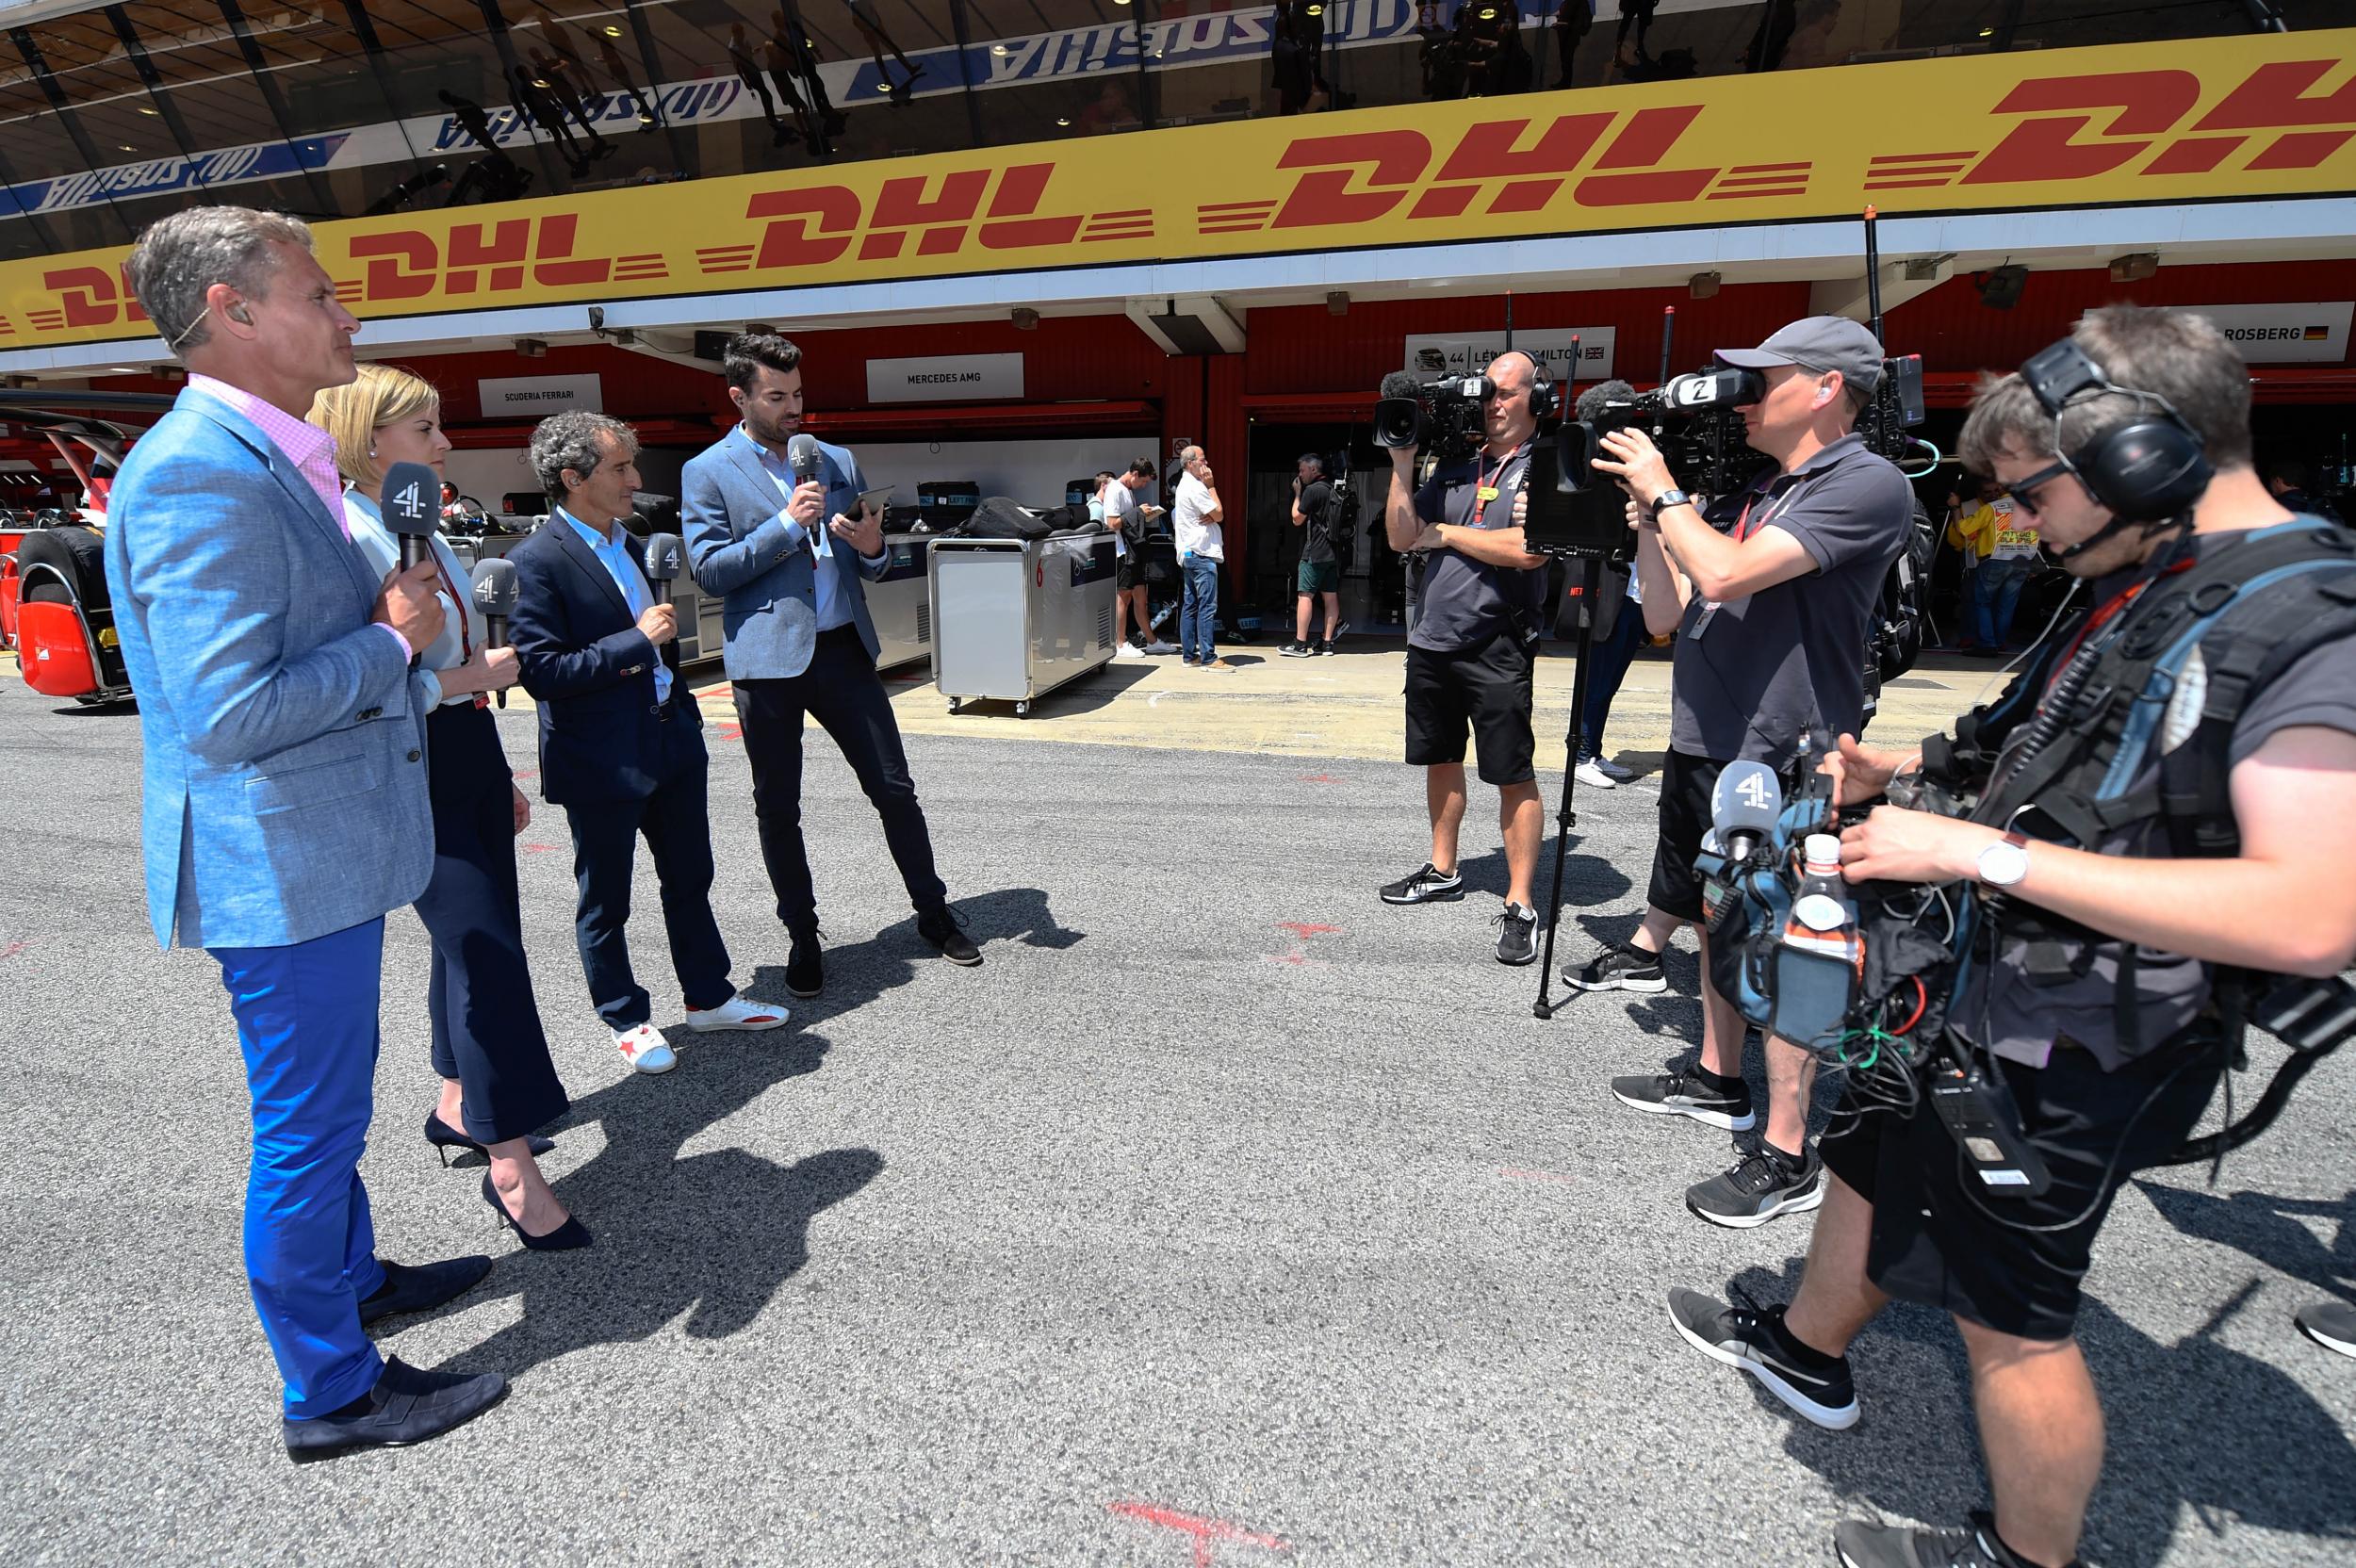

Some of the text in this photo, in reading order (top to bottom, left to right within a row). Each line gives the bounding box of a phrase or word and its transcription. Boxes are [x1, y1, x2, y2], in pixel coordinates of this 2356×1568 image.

[1958, 58, 2356, 186] DH
[1269, 104, 1723, 229] DHL
[745, 162, 1084, 270] DHL
[350, 213, 612, 302] DHL
[2224, 327, 2300, 341] ROSBERG
[1449, 352, 1464, 364] 44
[908, 372, 981, 384] MERCEDES AMG
[1467, 380, 1478, 395] 1
[504, 390, 574, 401] SCUDERIA FERRARI
[1693, 380, 1710, 400] 2
[392, 481, 427, 519] 4
